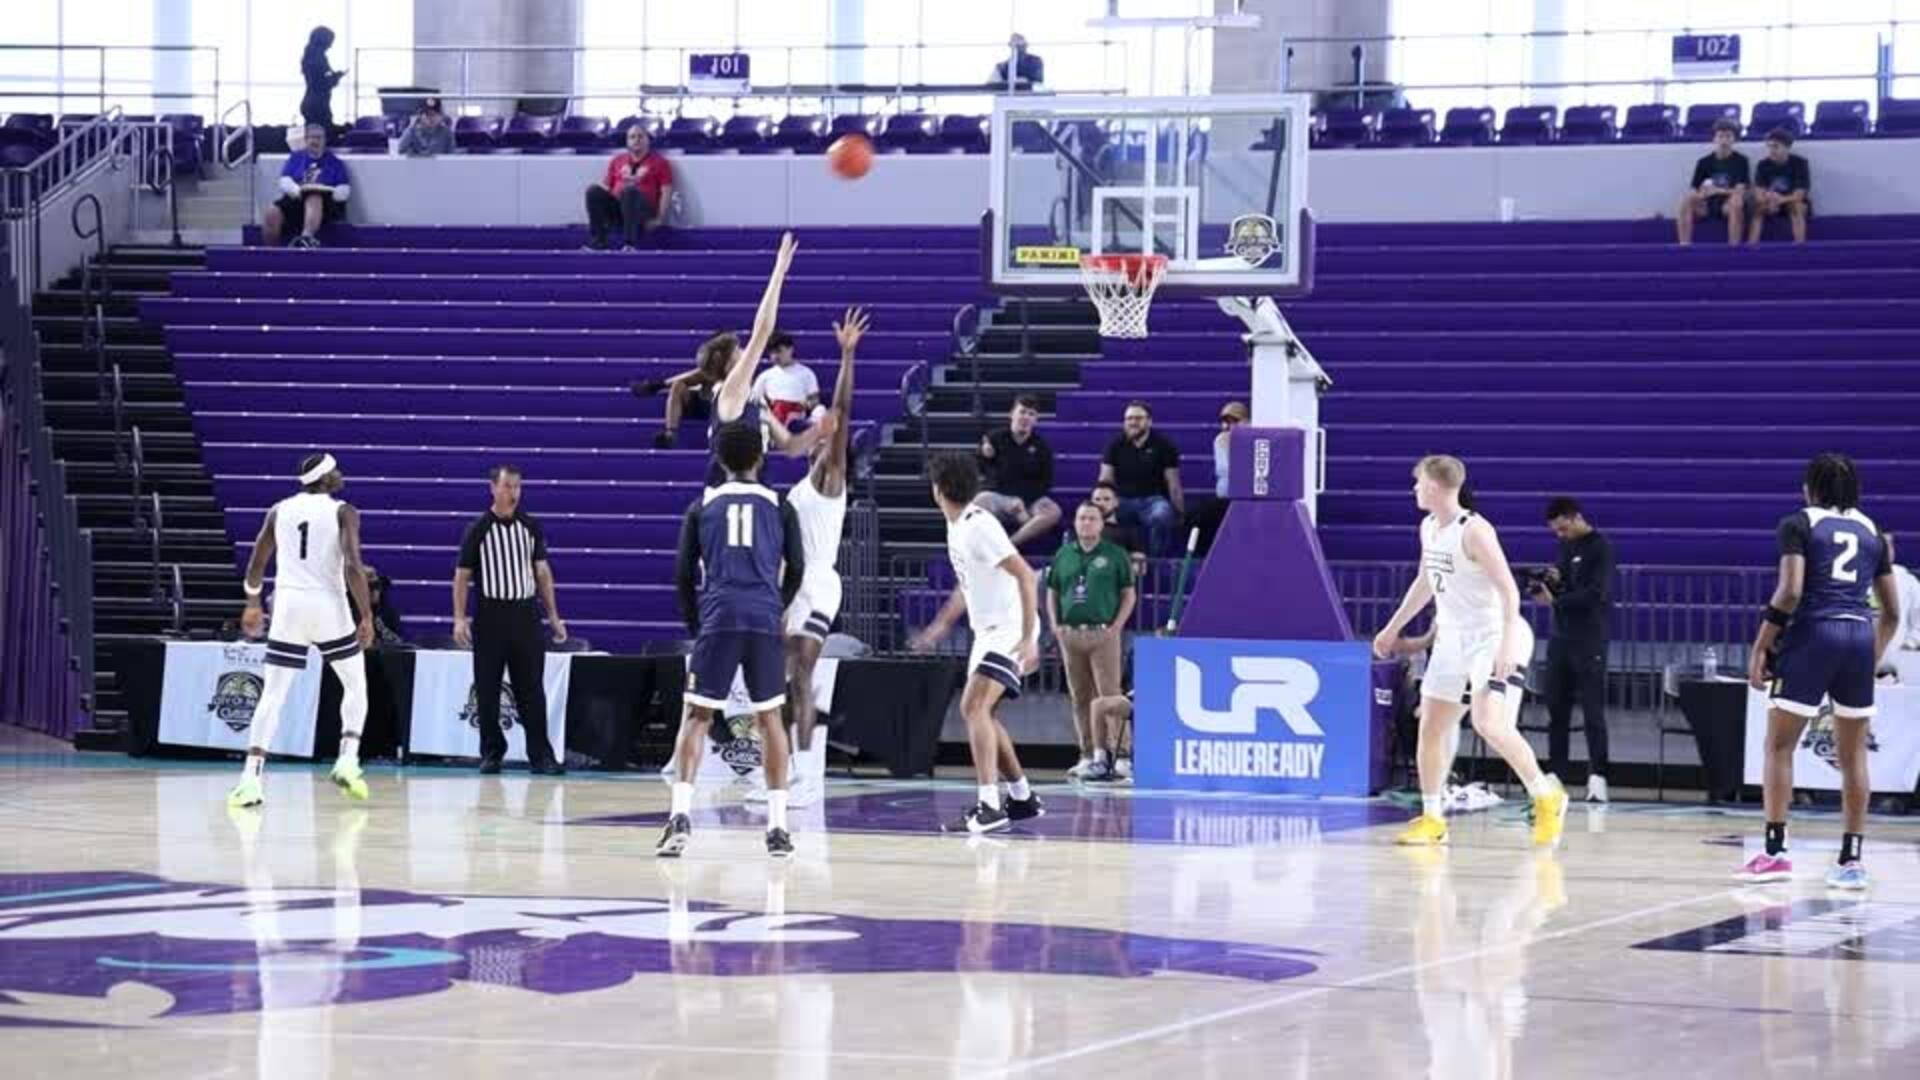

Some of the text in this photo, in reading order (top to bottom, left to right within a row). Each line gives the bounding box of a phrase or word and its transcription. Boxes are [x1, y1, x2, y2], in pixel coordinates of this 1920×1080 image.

[1697, 37, 1730, 56] 102
[1020, 249, 1076, 260] PANINI
[297, 520, 309, 560] 1
[727, 503, 753, 547] 11
[1832, 531, 1858, 582] 2
[1175, 739, 1325, 779] LEAGUEREADY
